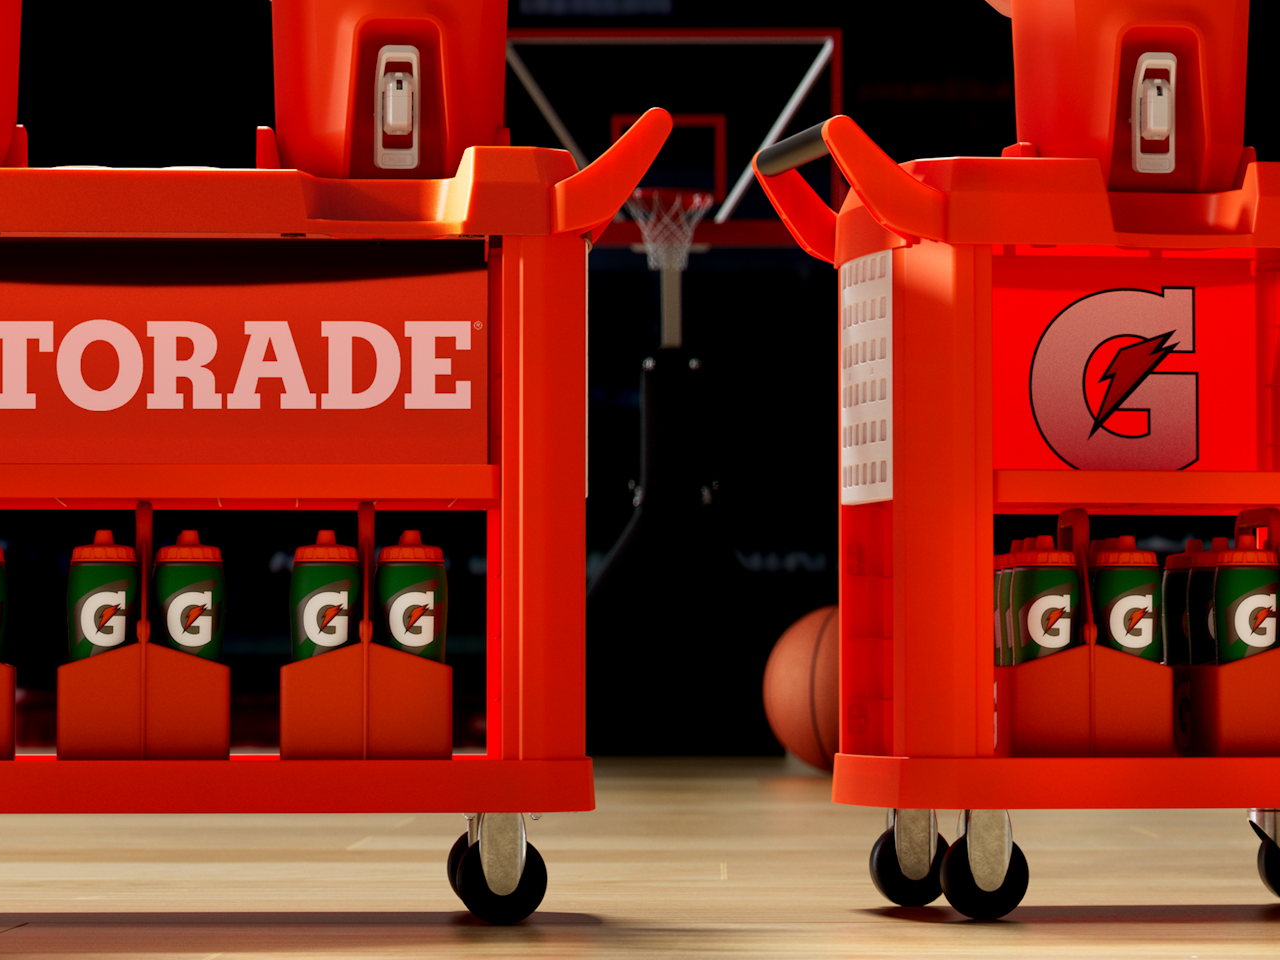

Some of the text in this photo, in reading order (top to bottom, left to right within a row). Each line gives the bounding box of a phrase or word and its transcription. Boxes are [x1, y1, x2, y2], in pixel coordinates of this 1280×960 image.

[1028, 286, 1200, 471] G
[80, 590, 126, 647] G
[167, 590, 213, 647] G
[303, 590, 349, 647] G
[389, 590, 435, 647] G
[1027, 594, 1071, 649] G
[1109, 594, 1153, 649] G
[1234, 593, 1277, 648] G
